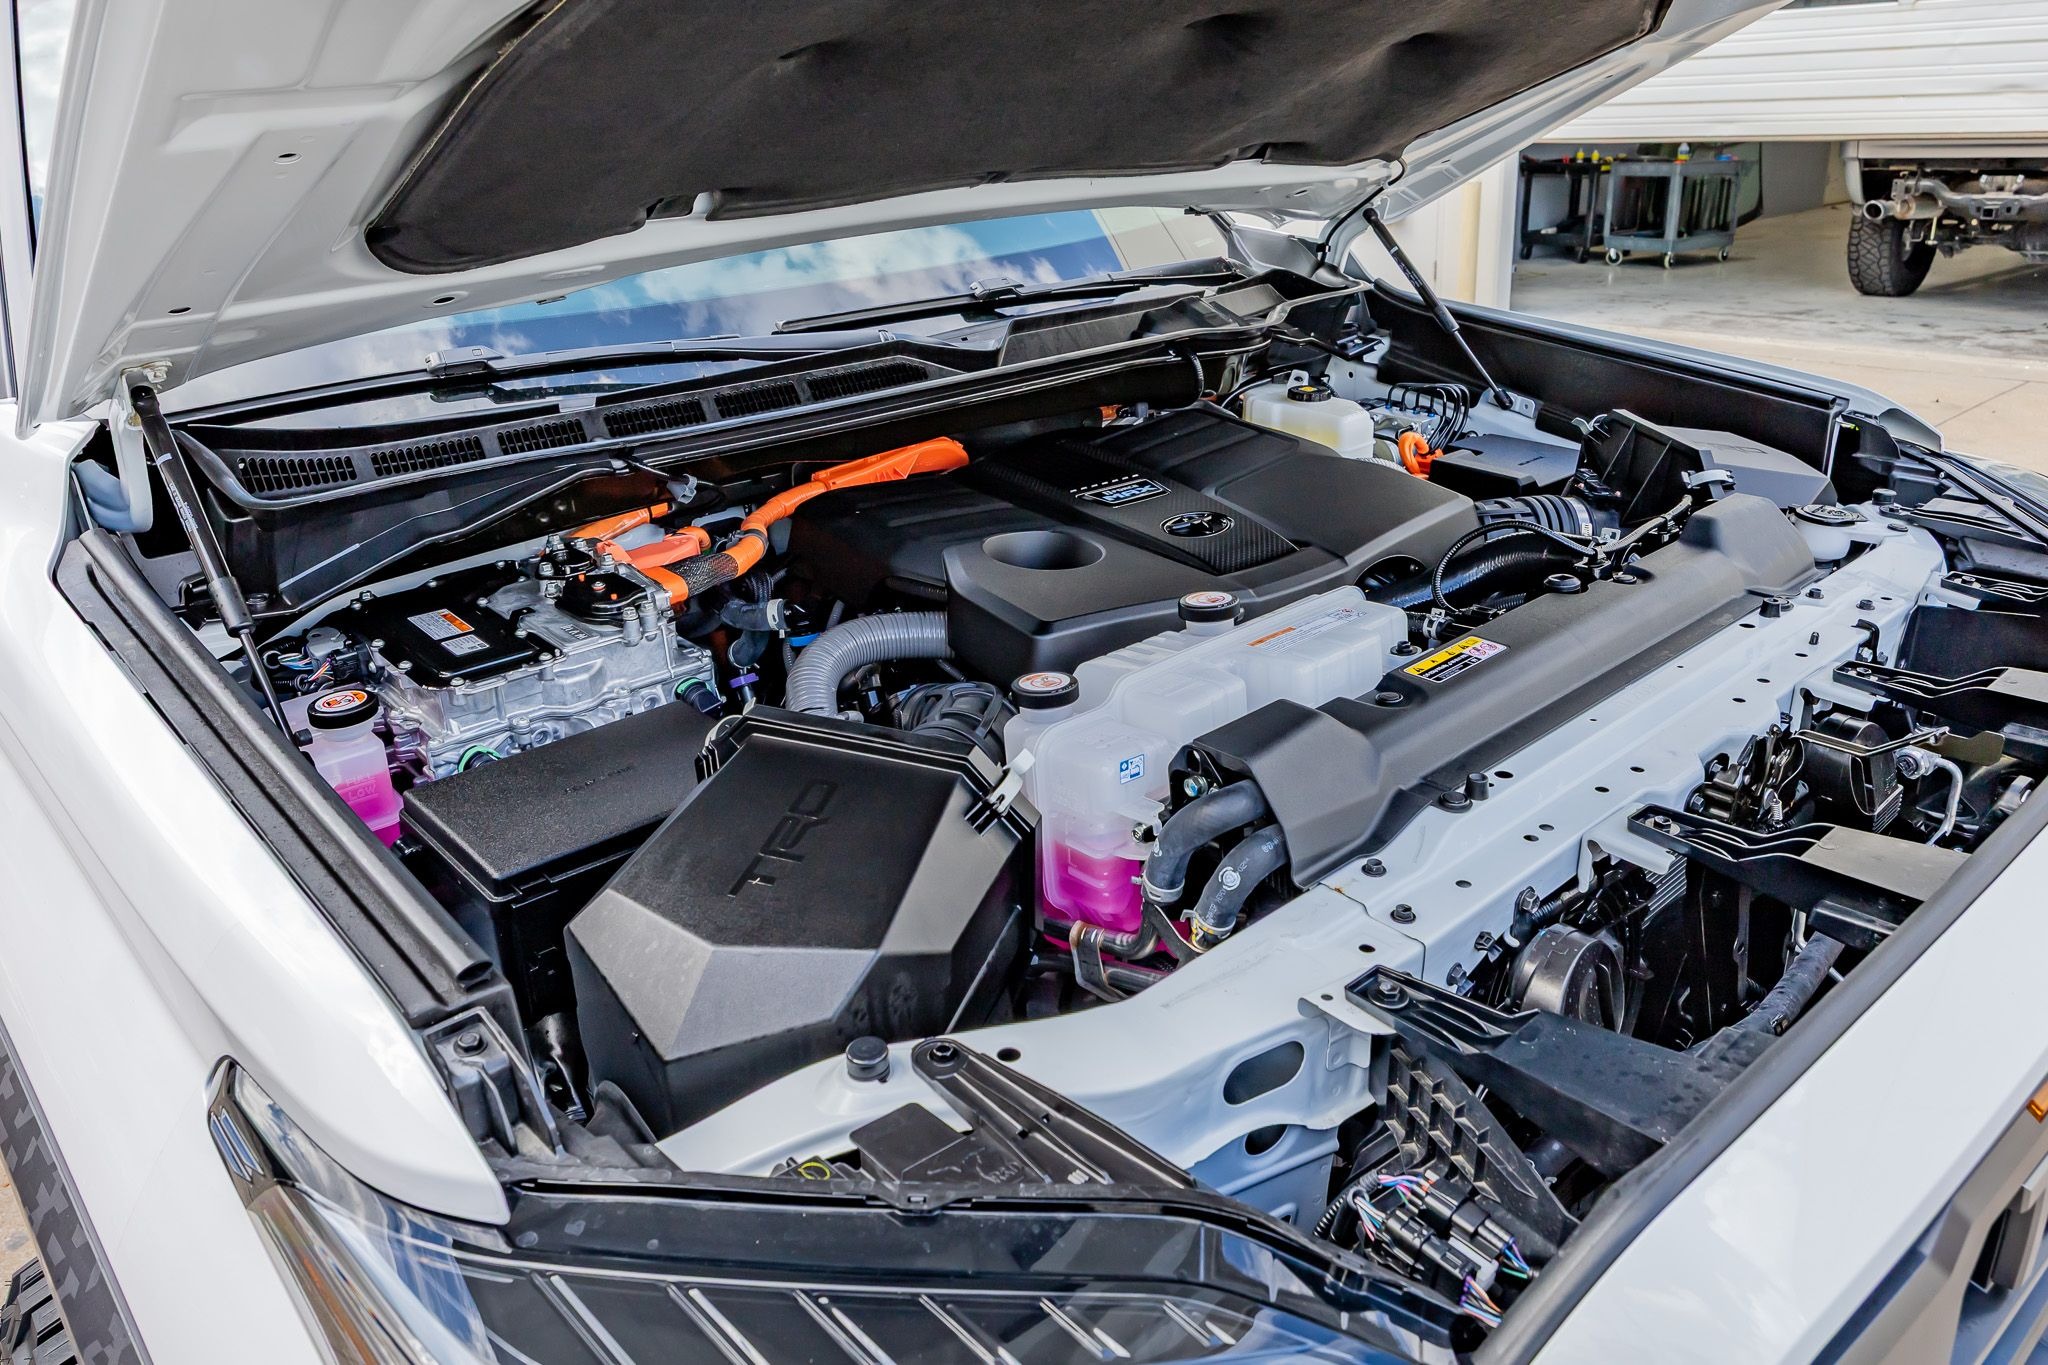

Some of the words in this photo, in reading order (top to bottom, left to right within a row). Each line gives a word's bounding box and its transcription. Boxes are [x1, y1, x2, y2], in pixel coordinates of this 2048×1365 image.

[1101, 484, 1158, 502] MAX
[348, 783, 376, 800] LOW
[727, 778, 840, 898] TRD
